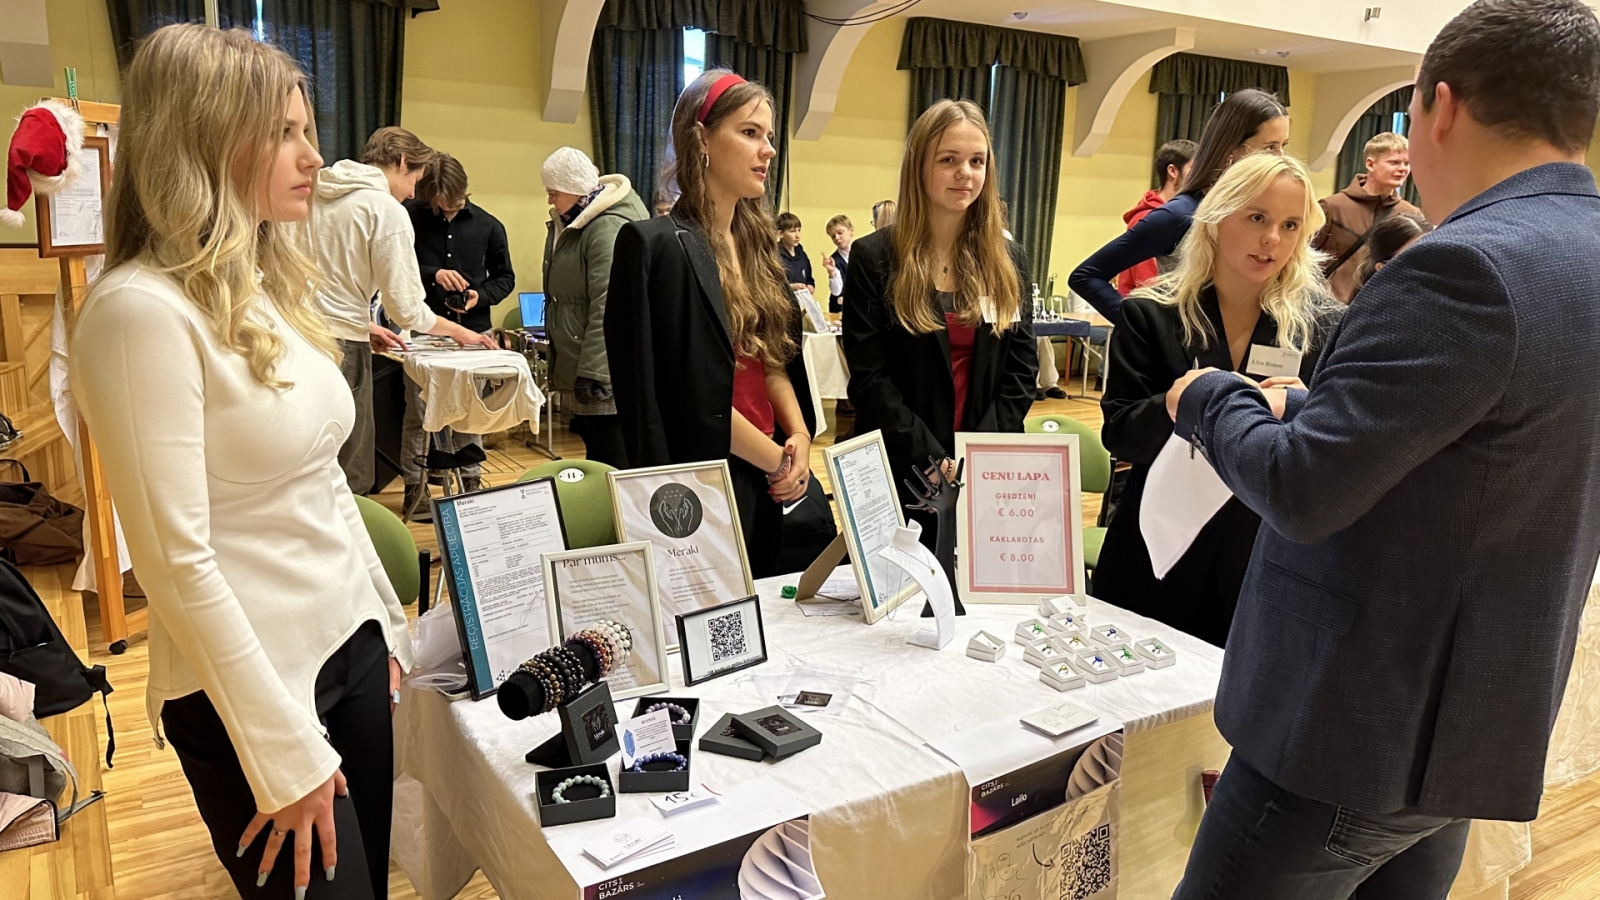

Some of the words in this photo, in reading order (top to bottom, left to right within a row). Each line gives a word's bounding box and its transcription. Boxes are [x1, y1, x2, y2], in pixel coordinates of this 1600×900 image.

[981, 471, 1015, 480] CENU
[1017, 472, 1050, 481] LAPA
[995, 492, 1036, 500] GREDZENI
[998, 508, 1005, 517] €
[1008, 508, 1035, 517] 6.00
[442, 508, 462, 566] APLIECĪBA
[989, 536, 1044, 544] KAKLAROTAS
[667, 544, 699, 558] Meraki
[562, 557, 581, 569] Par
[1000, 553, 1006, 561] €
[1010, 553, 1034, 562] 8.00
[455, 567, 480, 650] REĢISTRĀCIJAS
[665, 792, 689, 804] 15
[1011, 793, 1028, 807] Lailo
[598, 882, 635, 900] BAZĀRS
